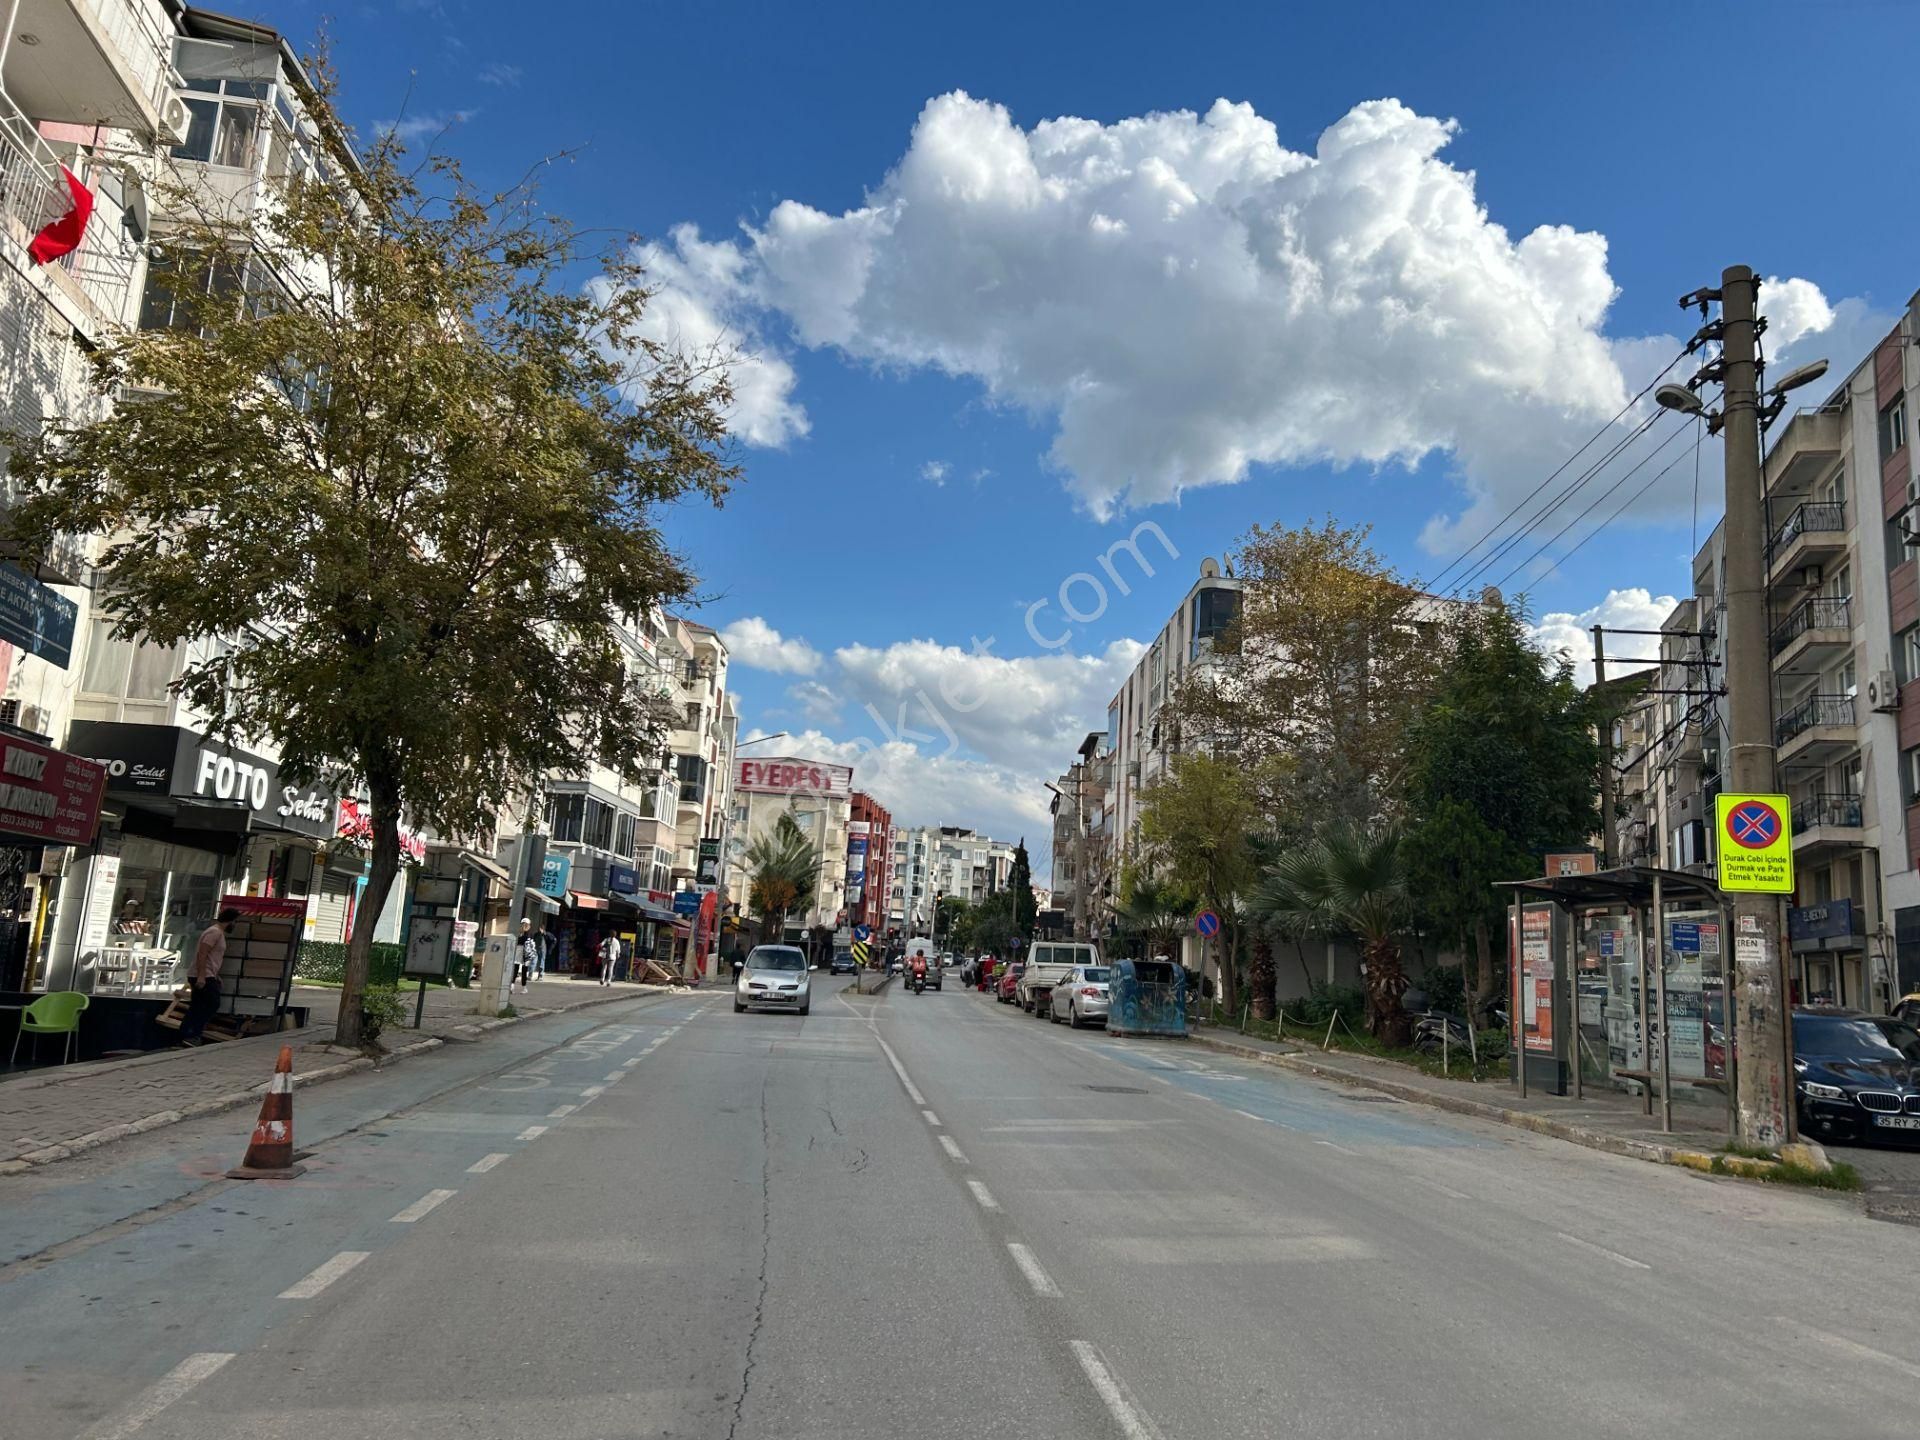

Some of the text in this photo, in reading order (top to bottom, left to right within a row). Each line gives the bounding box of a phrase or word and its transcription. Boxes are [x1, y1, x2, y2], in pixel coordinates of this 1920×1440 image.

[130, 764, 166, 778] Sedat
[193, 749, 269, 811] FOTO
[1724, 854, 1745, 862] Durak
[1747, 854, 1763, 862] Cebi
[884, 828, 897, 908] EVEREST
[1727, 864, 1755, 872] Durmak
[1768, 865, 1785, 873] Park
[1728, 873, 1752, 881] Etmek
[1879, 1116, 1891, 1126] 35
[1895, 1118, 1909, 1127] RY
